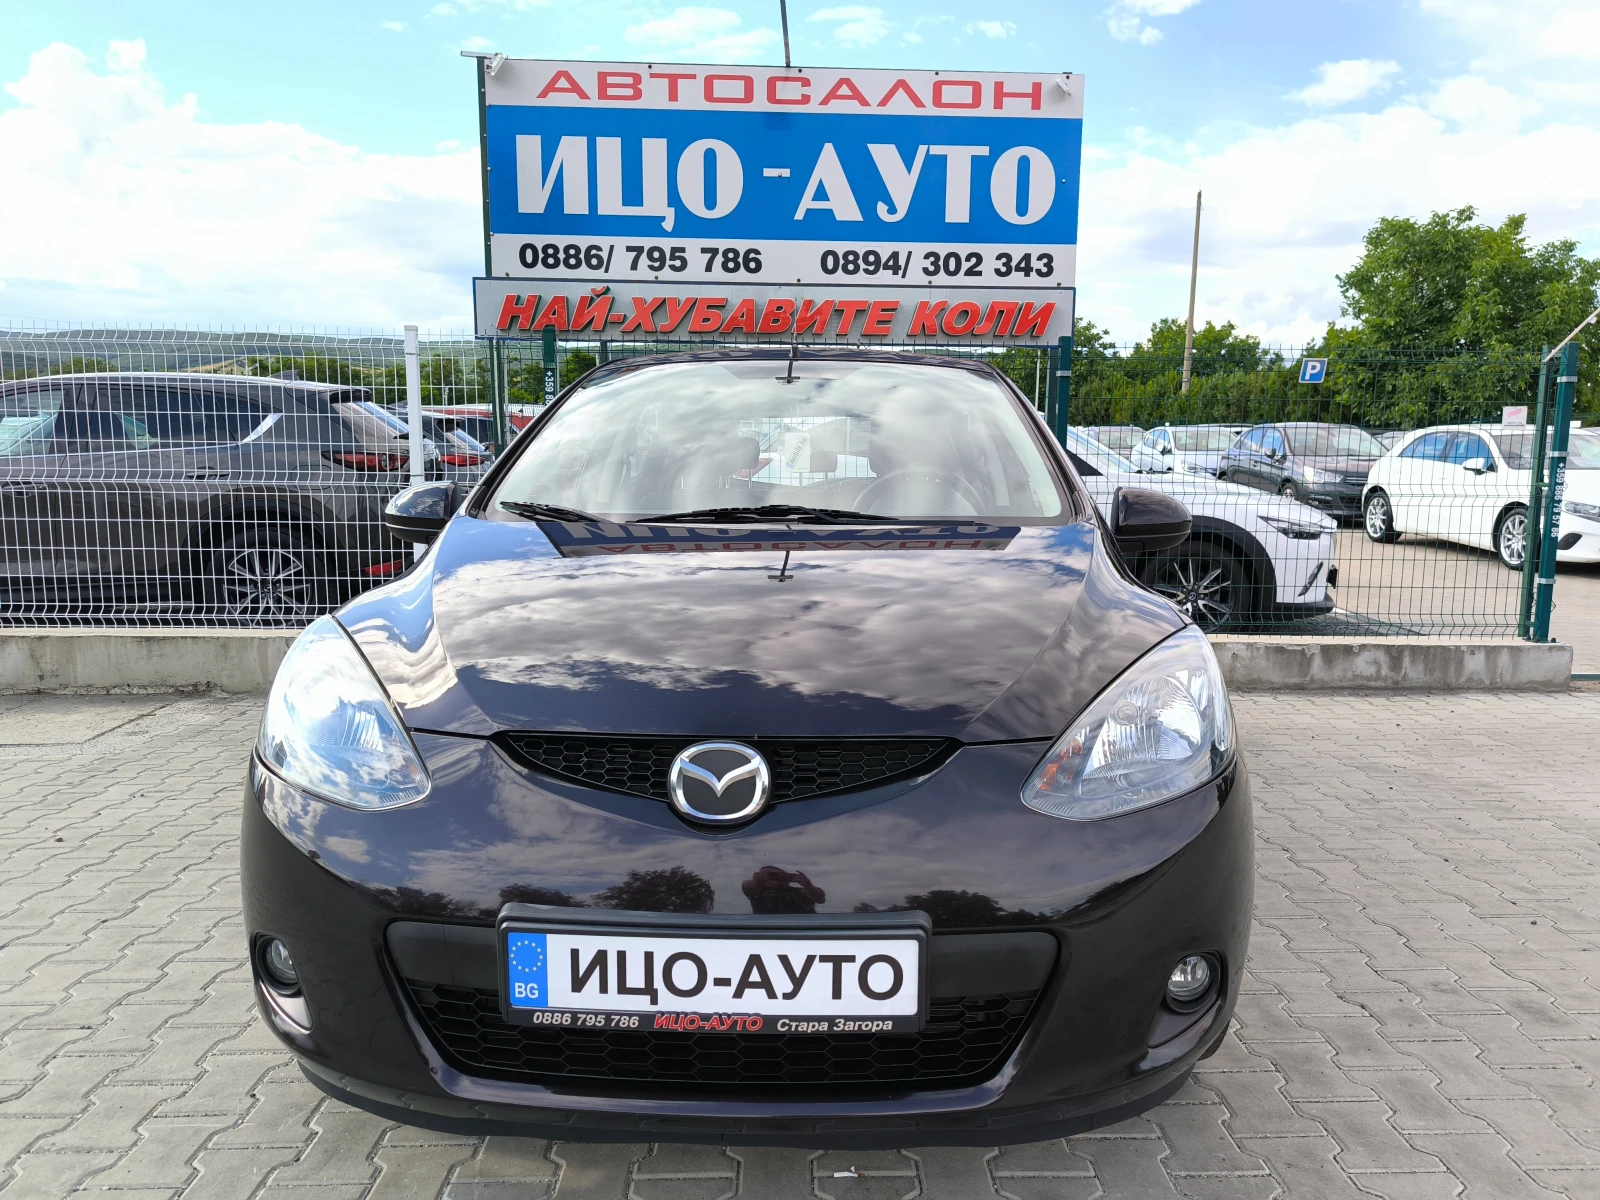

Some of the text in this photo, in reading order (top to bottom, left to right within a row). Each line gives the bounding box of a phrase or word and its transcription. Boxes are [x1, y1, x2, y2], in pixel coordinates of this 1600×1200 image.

[536, 70, 1042, 111] АВТОСАЛОН
[518, 242, 763, 274] 0886/ 795 786
[820, 249, 1055, 278] 0894/ 302 343
[496, 285, 1057, 337] НАЙ-ХУБАВИТЕ КОЛИ
[545, 370, 554, 392] +359
[1305, 361, 1321, 380] P
[1551, 462, 1565, 538] +359 886 79 57 86
[514, 982, 539, 999] BG
[569, 948, 905, 1006] ИЦО-АУТО
[533, 1011, 893, 1033] 0886 795 786 ИЦО-АУТО Стара Загора
